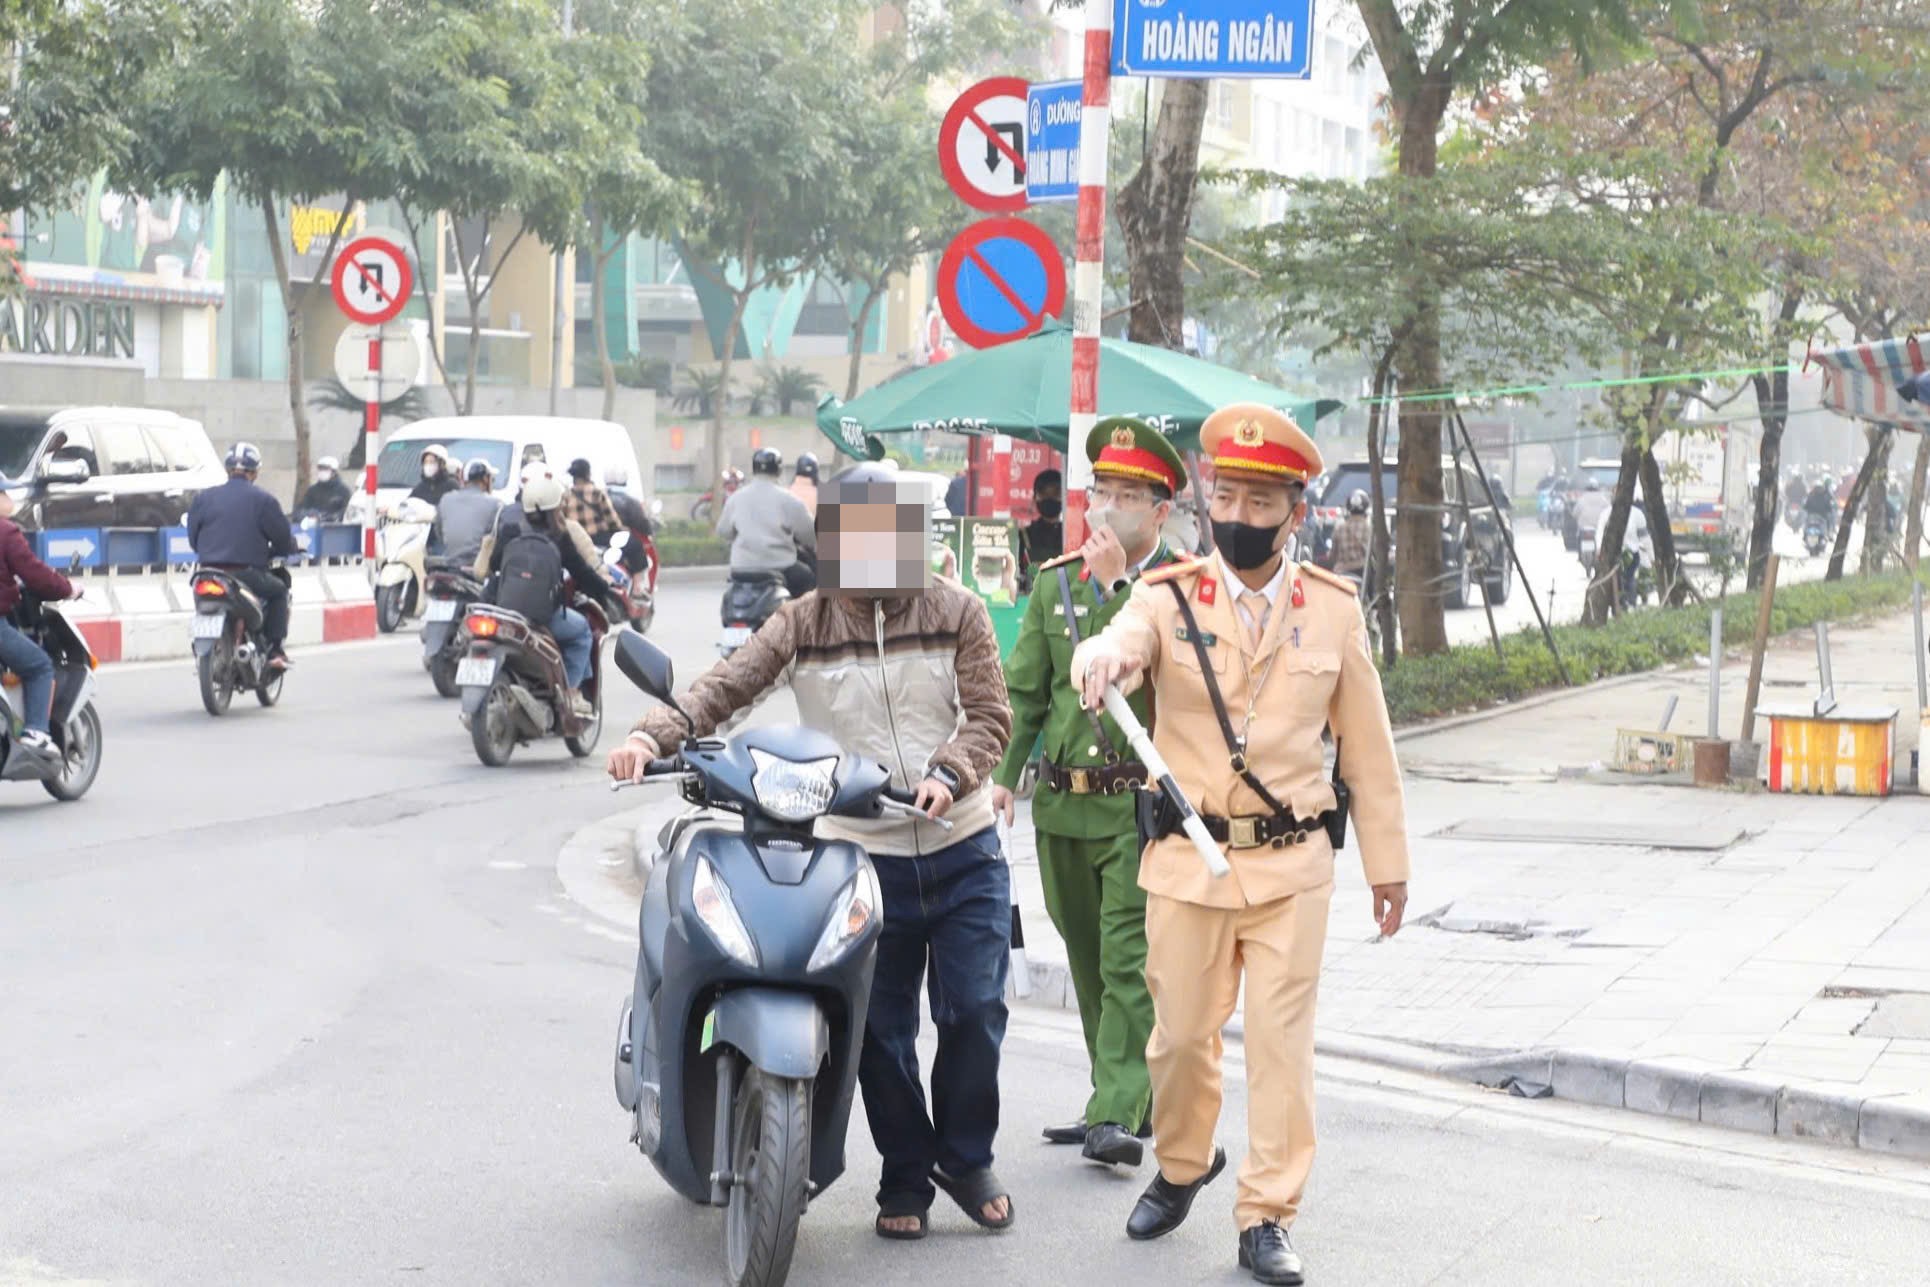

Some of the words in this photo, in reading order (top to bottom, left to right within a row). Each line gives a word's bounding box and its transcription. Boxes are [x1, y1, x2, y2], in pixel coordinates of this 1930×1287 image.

[1142, 12, 1219, 62] HOÀNG
[1227, 13, 1293, 63] NGÂN
[1046, 95, 1081, 126] ĐƯỜNG
